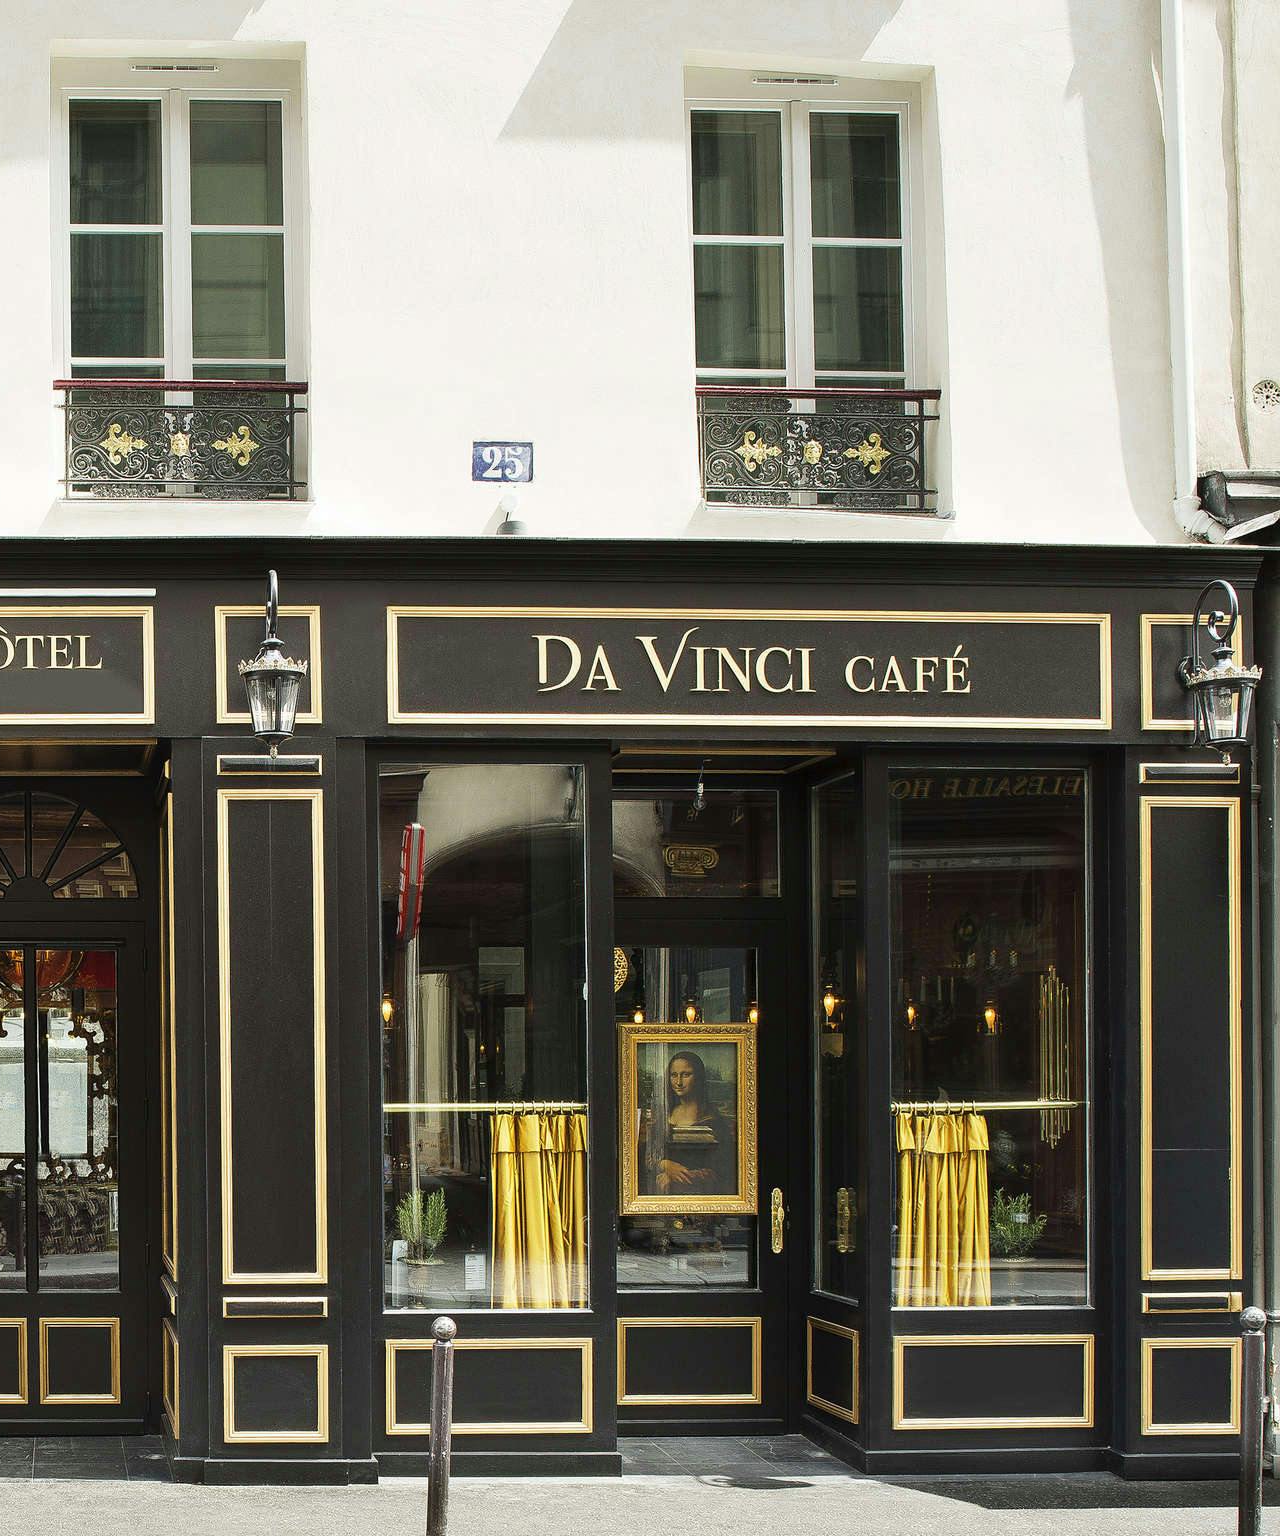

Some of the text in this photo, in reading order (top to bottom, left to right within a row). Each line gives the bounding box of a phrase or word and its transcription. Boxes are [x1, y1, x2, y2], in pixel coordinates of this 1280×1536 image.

[482, 446, 524, 481] 25
[635, 626, 817, 694] VINCI
[844, 644, 972, 694] CAFÉ
